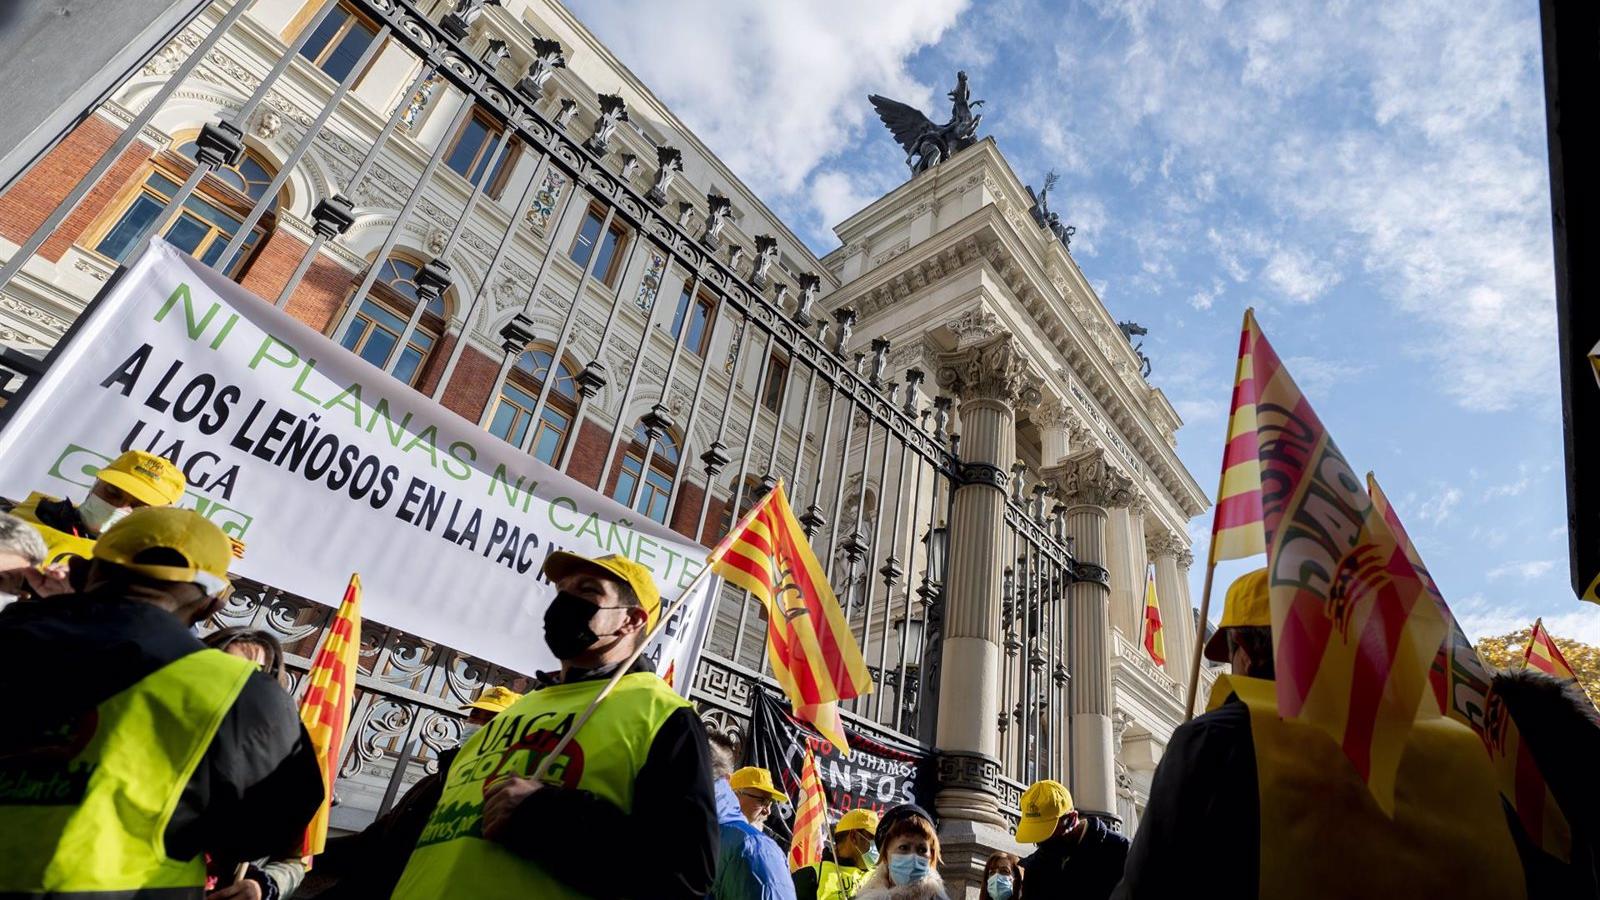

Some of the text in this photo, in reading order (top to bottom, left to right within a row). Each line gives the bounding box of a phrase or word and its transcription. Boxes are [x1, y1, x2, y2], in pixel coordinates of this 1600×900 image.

[100, 343, 154, 398] A
[144, 359, 241, 435] LOS
[230, 398, 400, 509] LEÑOSOS
[395, 476, 446, 532] EN
[441, 498, 483, 553] LA
[483, 517, 539, 575] PAC
[120, 420, 241, 501] UAGA
[153, 282, 240, 350] NI
[248, 334, 478, 481] PLANAS
[487, 463, 539, 513] NI
[547, 496, 703, 591] CAÑETE
[477, 712, 577, 757] UAGA
[814, 756, 917, 806] NTOS
